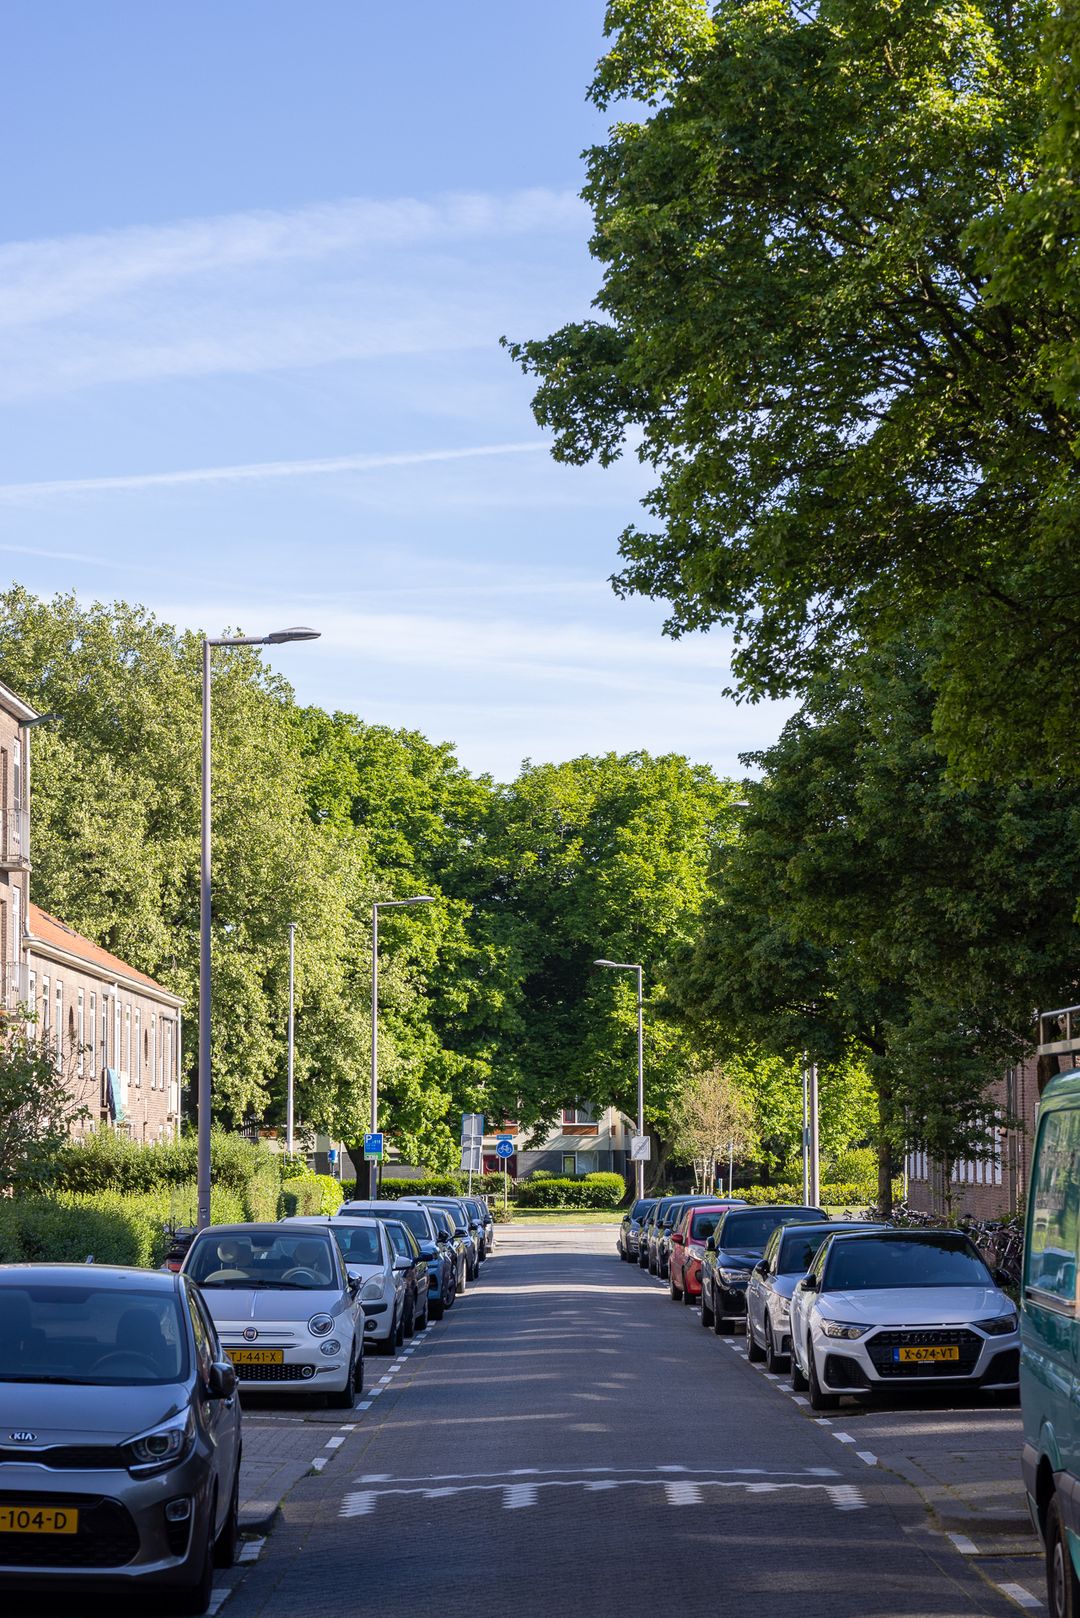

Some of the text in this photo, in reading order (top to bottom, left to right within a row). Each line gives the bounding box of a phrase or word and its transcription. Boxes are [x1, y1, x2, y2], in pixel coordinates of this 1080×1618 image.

[230, 1352, 276, 1362] TJ-441-X
[904, 1348, 954, 1360] X-674-VT
[14, 1432, 33, 1440] KIA
